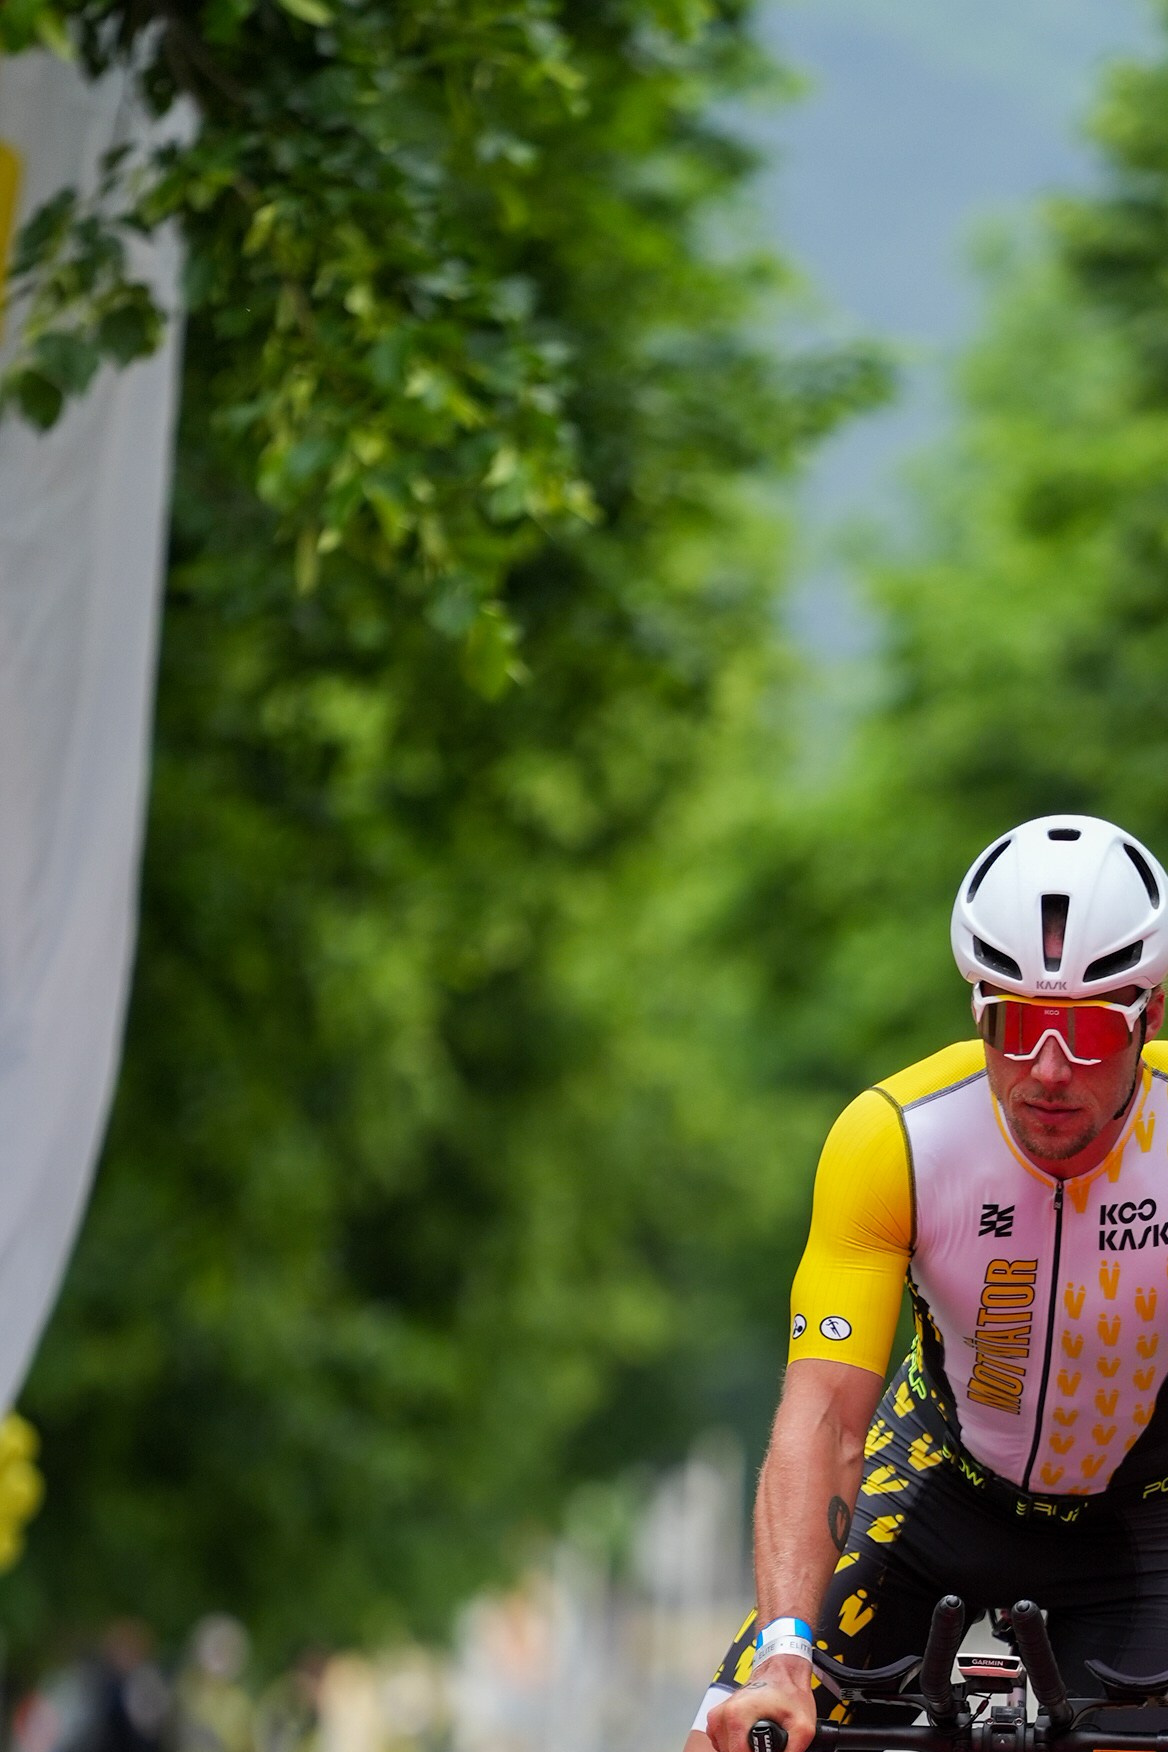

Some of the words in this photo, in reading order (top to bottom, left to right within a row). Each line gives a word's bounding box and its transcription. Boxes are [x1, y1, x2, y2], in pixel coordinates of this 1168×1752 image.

[1036, 980, 1067, 991] KASK
[1099, 1198, 1157, 1226] KOO
[971, 1658, 1004, 1667] GARMIN
